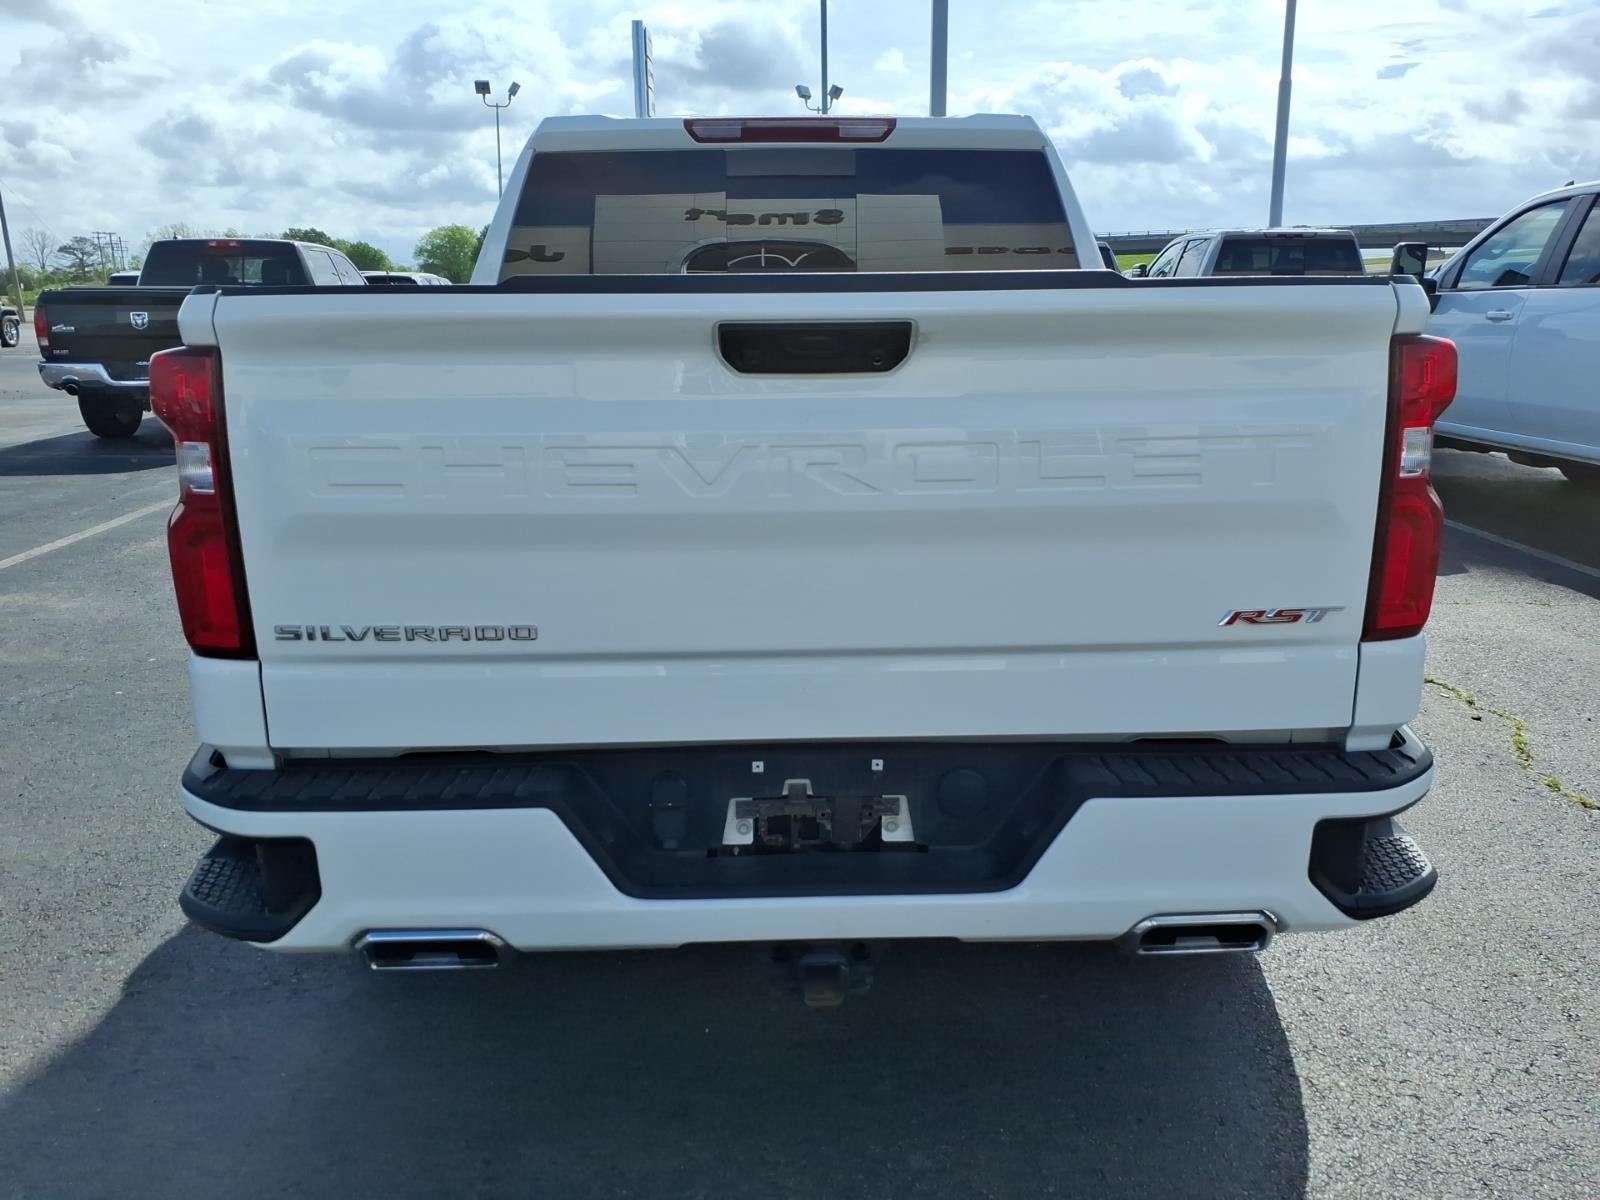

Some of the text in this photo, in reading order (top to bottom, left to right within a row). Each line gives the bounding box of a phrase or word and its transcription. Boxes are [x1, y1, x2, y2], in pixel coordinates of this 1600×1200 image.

[308, 433, 1315, 497] CHEVROLET
[1217, 606, 1346, 626] RST
[274, 624, 538, 642] SILVERADO
